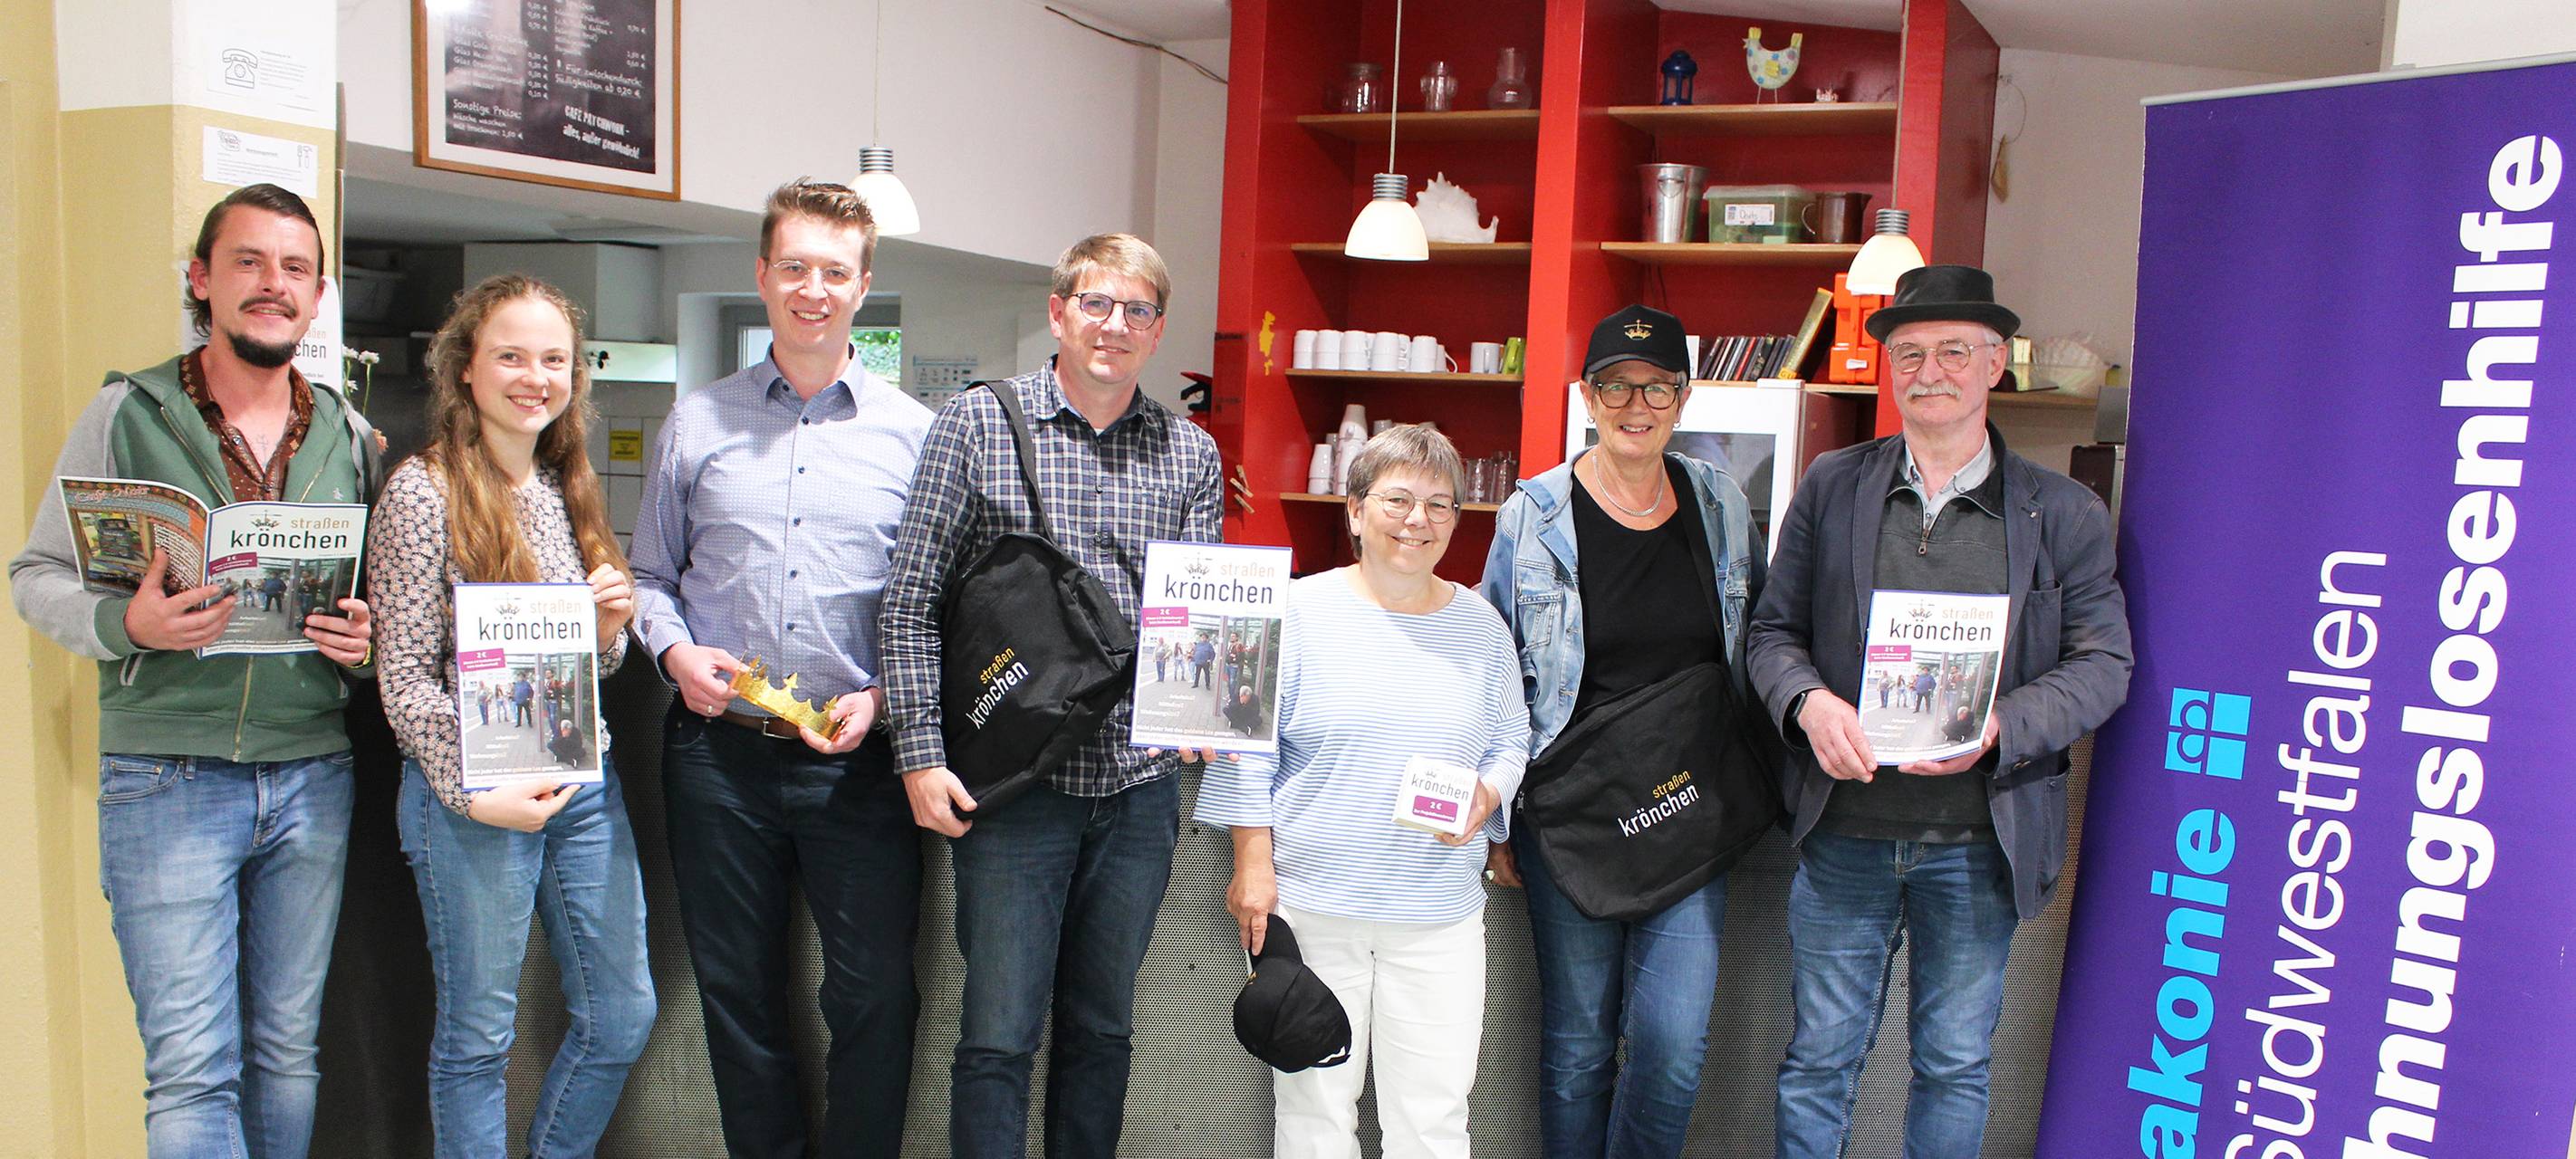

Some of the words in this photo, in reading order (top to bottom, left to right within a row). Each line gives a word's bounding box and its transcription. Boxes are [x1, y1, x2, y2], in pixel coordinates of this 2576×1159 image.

[453, 99, 490, 116] Sonstige
[493, 105, 523, 120] Preise:
[291, 516, 350, 529] straßen
[231, 528, 347, 549] krönchen
[1220, 561, 1275, 579] straßen
[1165, 574, 1273, 604] krönchen
[530, 599, 582, 614] straßen
[1942, 608, 1994, 620] straßen
[479, 617, 582, 640] krönchen
[1889, 618, 1991, 641] krönchen
[980, 647, 1015, 684] straßen
[966, 661, 1029, 730] krönchen
[1411, 773, 1469, 800] krönchen
[1652, 771, 1691, 799] straßen
[1618, 784, 1699, 837] krönchen
[2127, 808, 2237, 1159] akonie
